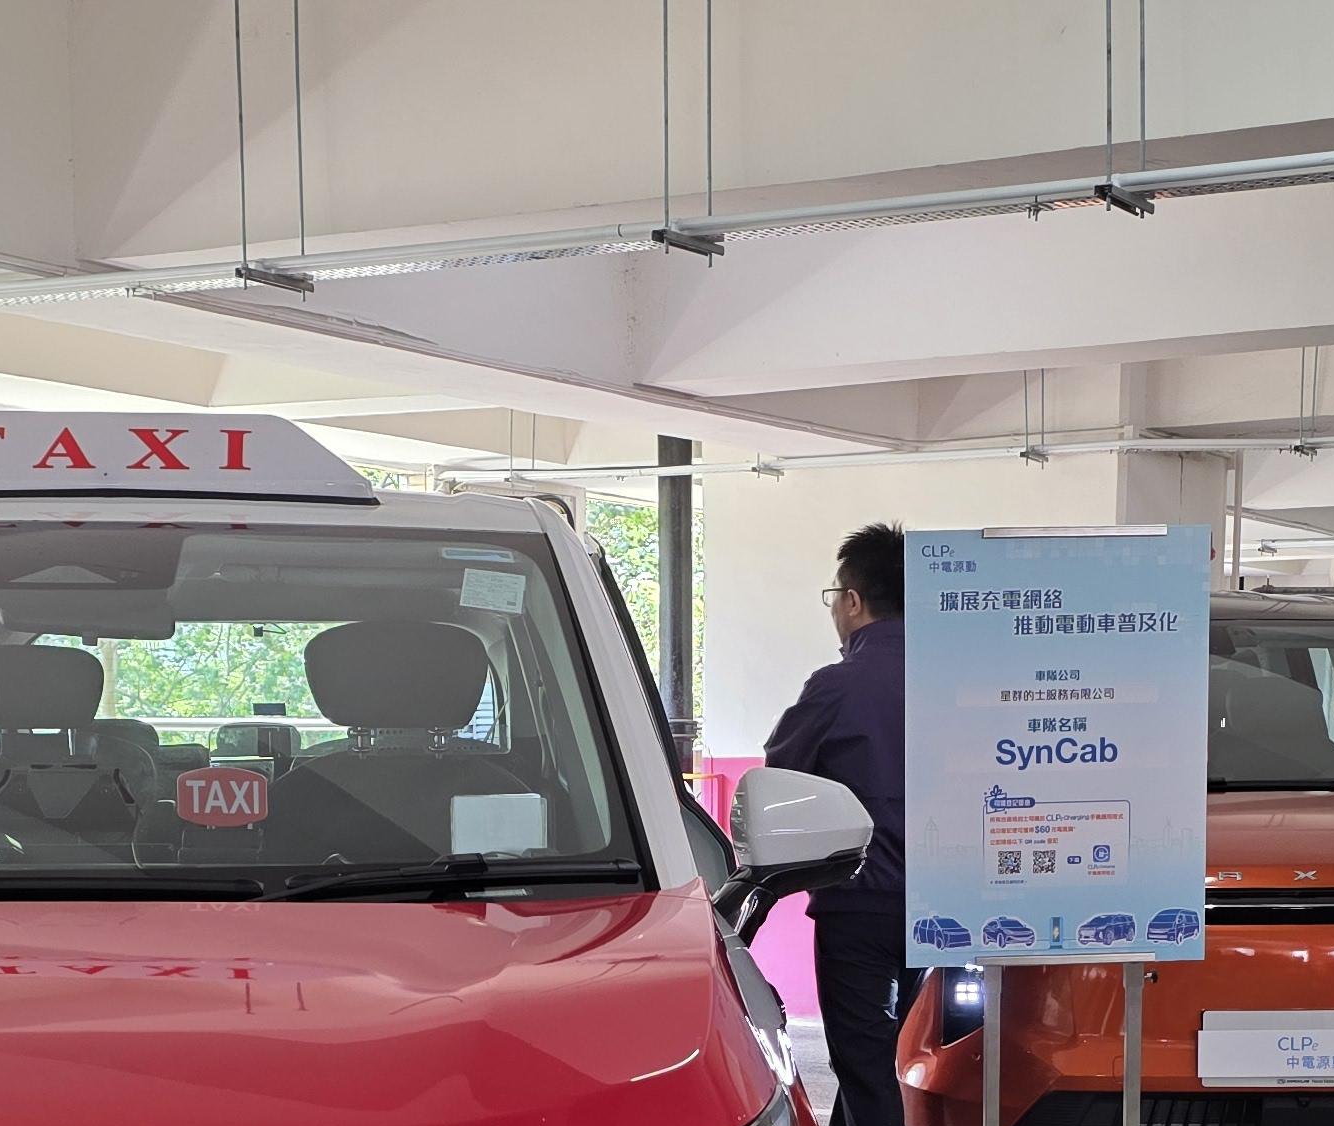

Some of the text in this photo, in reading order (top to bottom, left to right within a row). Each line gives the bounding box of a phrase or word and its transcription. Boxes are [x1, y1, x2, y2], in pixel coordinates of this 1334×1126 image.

[929, 560, 977, 573] 中電源動
[939, 589, 1063, 612] 擴展充電網絡
[1013, 611, 1178, 635] 推動電動車普及化
[1034, 669, 1080, 681] 車隊公司
[1000, 687, 1115, 702] 星群的士服務有限公司
[1027, 717, 1087, 732] 車隊名稱
[995, 737, 1118, 771] SynCab
[185, 780, 260, 814] TAXI
[1034, 825, 1051, 833] $60
